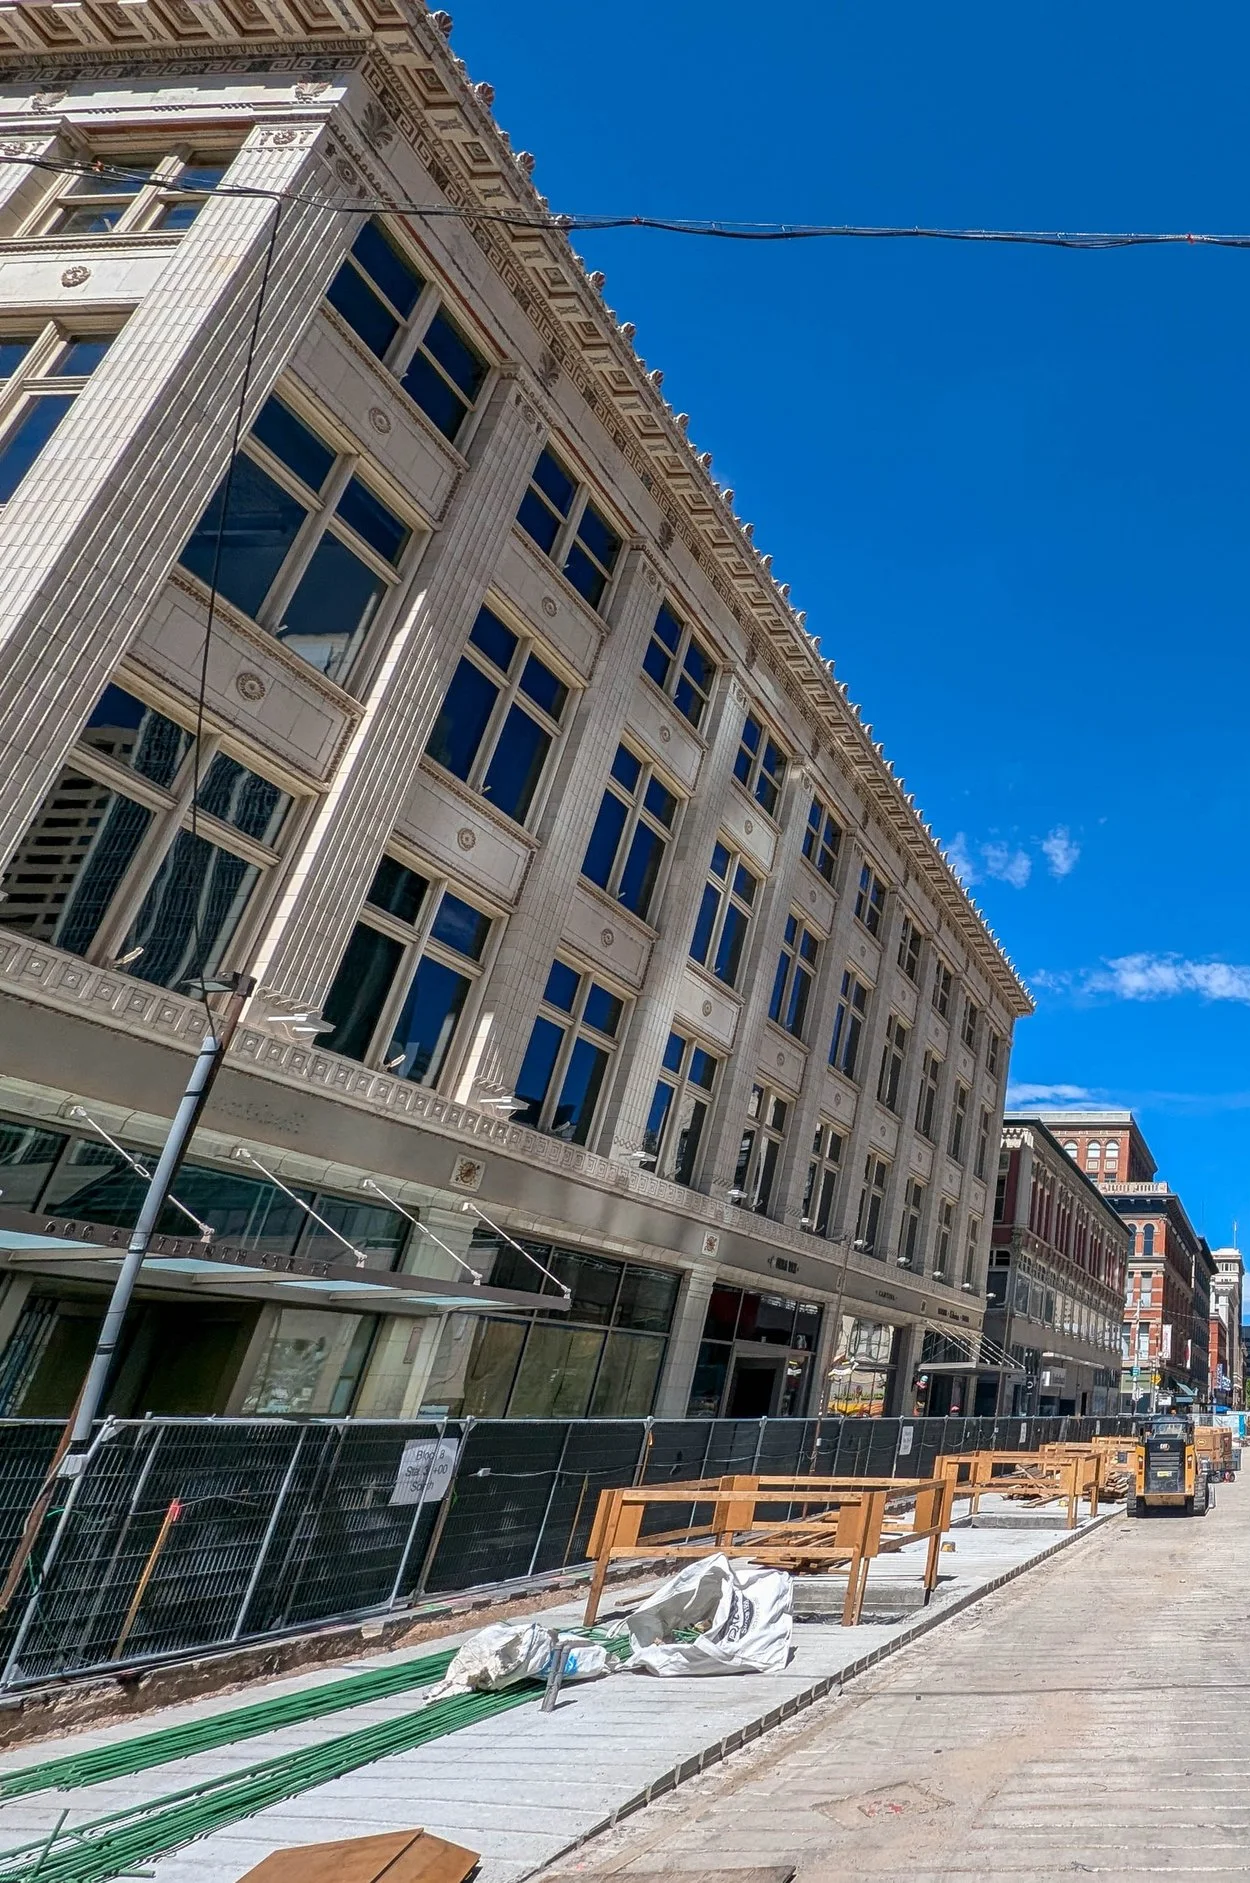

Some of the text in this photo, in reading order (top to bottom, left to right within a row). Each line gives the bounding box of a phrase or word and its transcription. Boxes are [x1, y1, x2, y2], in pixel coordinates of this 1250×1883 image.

[259, 1252, 333, 1275] STRET
[417, 1450, 438, 1460] Bloc
[423, 1464, 448, 1475] 3+00
